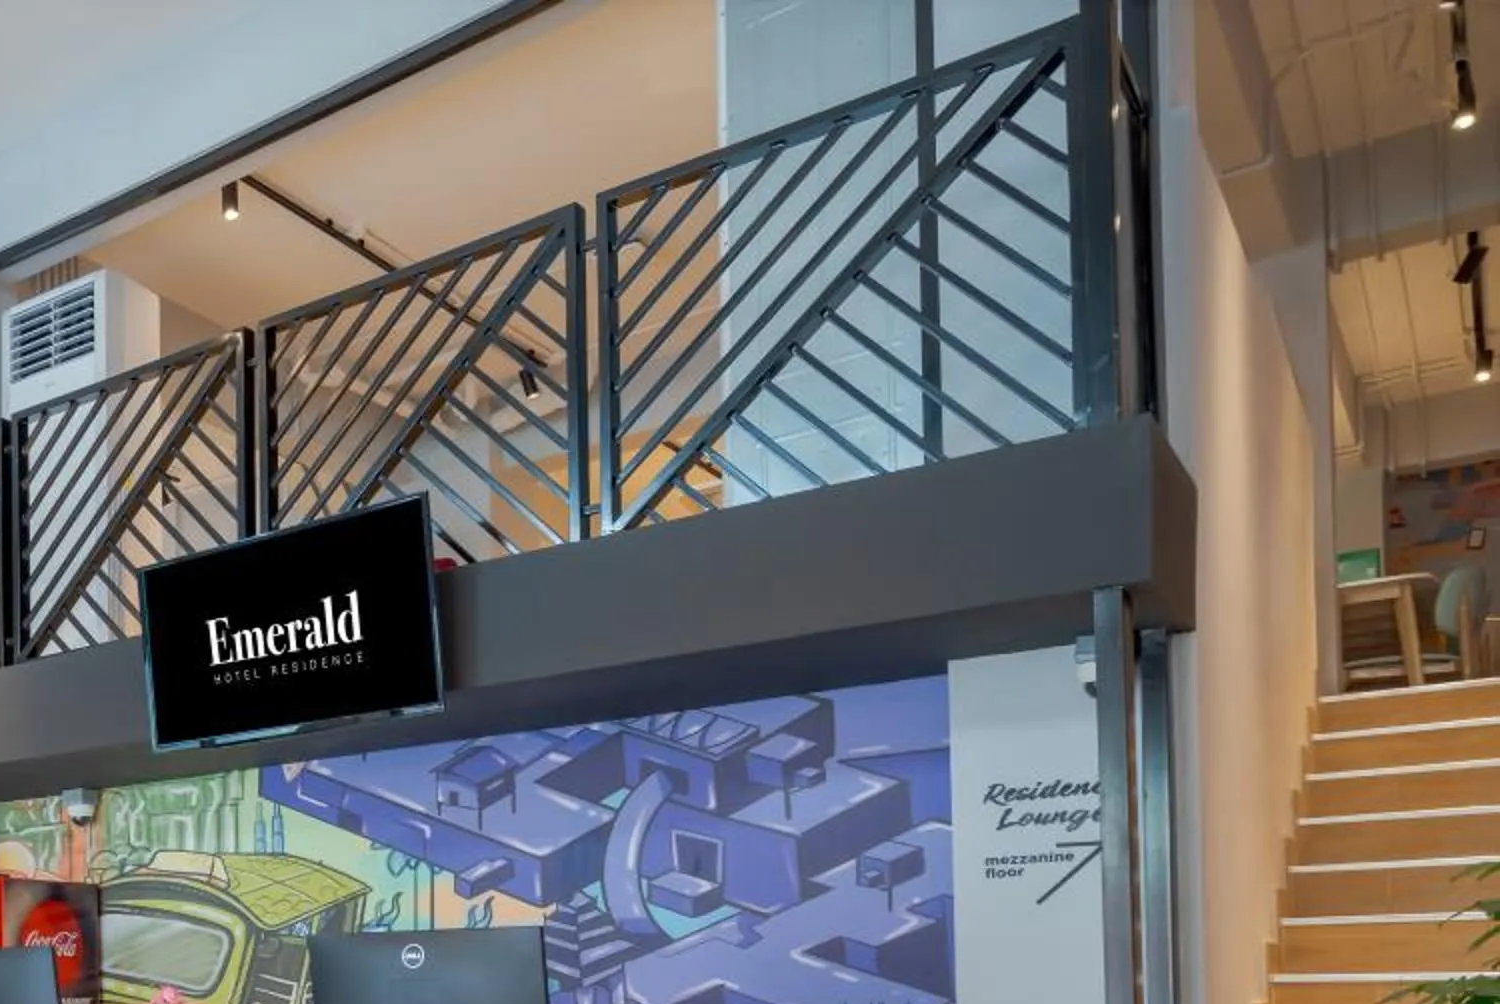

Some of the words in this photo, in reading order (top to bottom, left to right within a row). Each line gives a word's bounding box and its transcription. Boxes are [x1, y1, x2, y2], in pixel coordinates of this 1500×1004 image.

[205, 589, 363, 667] Emerald
[213, 669, 261, 685] HOTEL
[270, 651, 365, 677] RESIDENCE
[983, 779, 1101, 807] Residenc
[985, 853, 1075, 866] mezzanine
[985, 867, 1025, 879] floor
